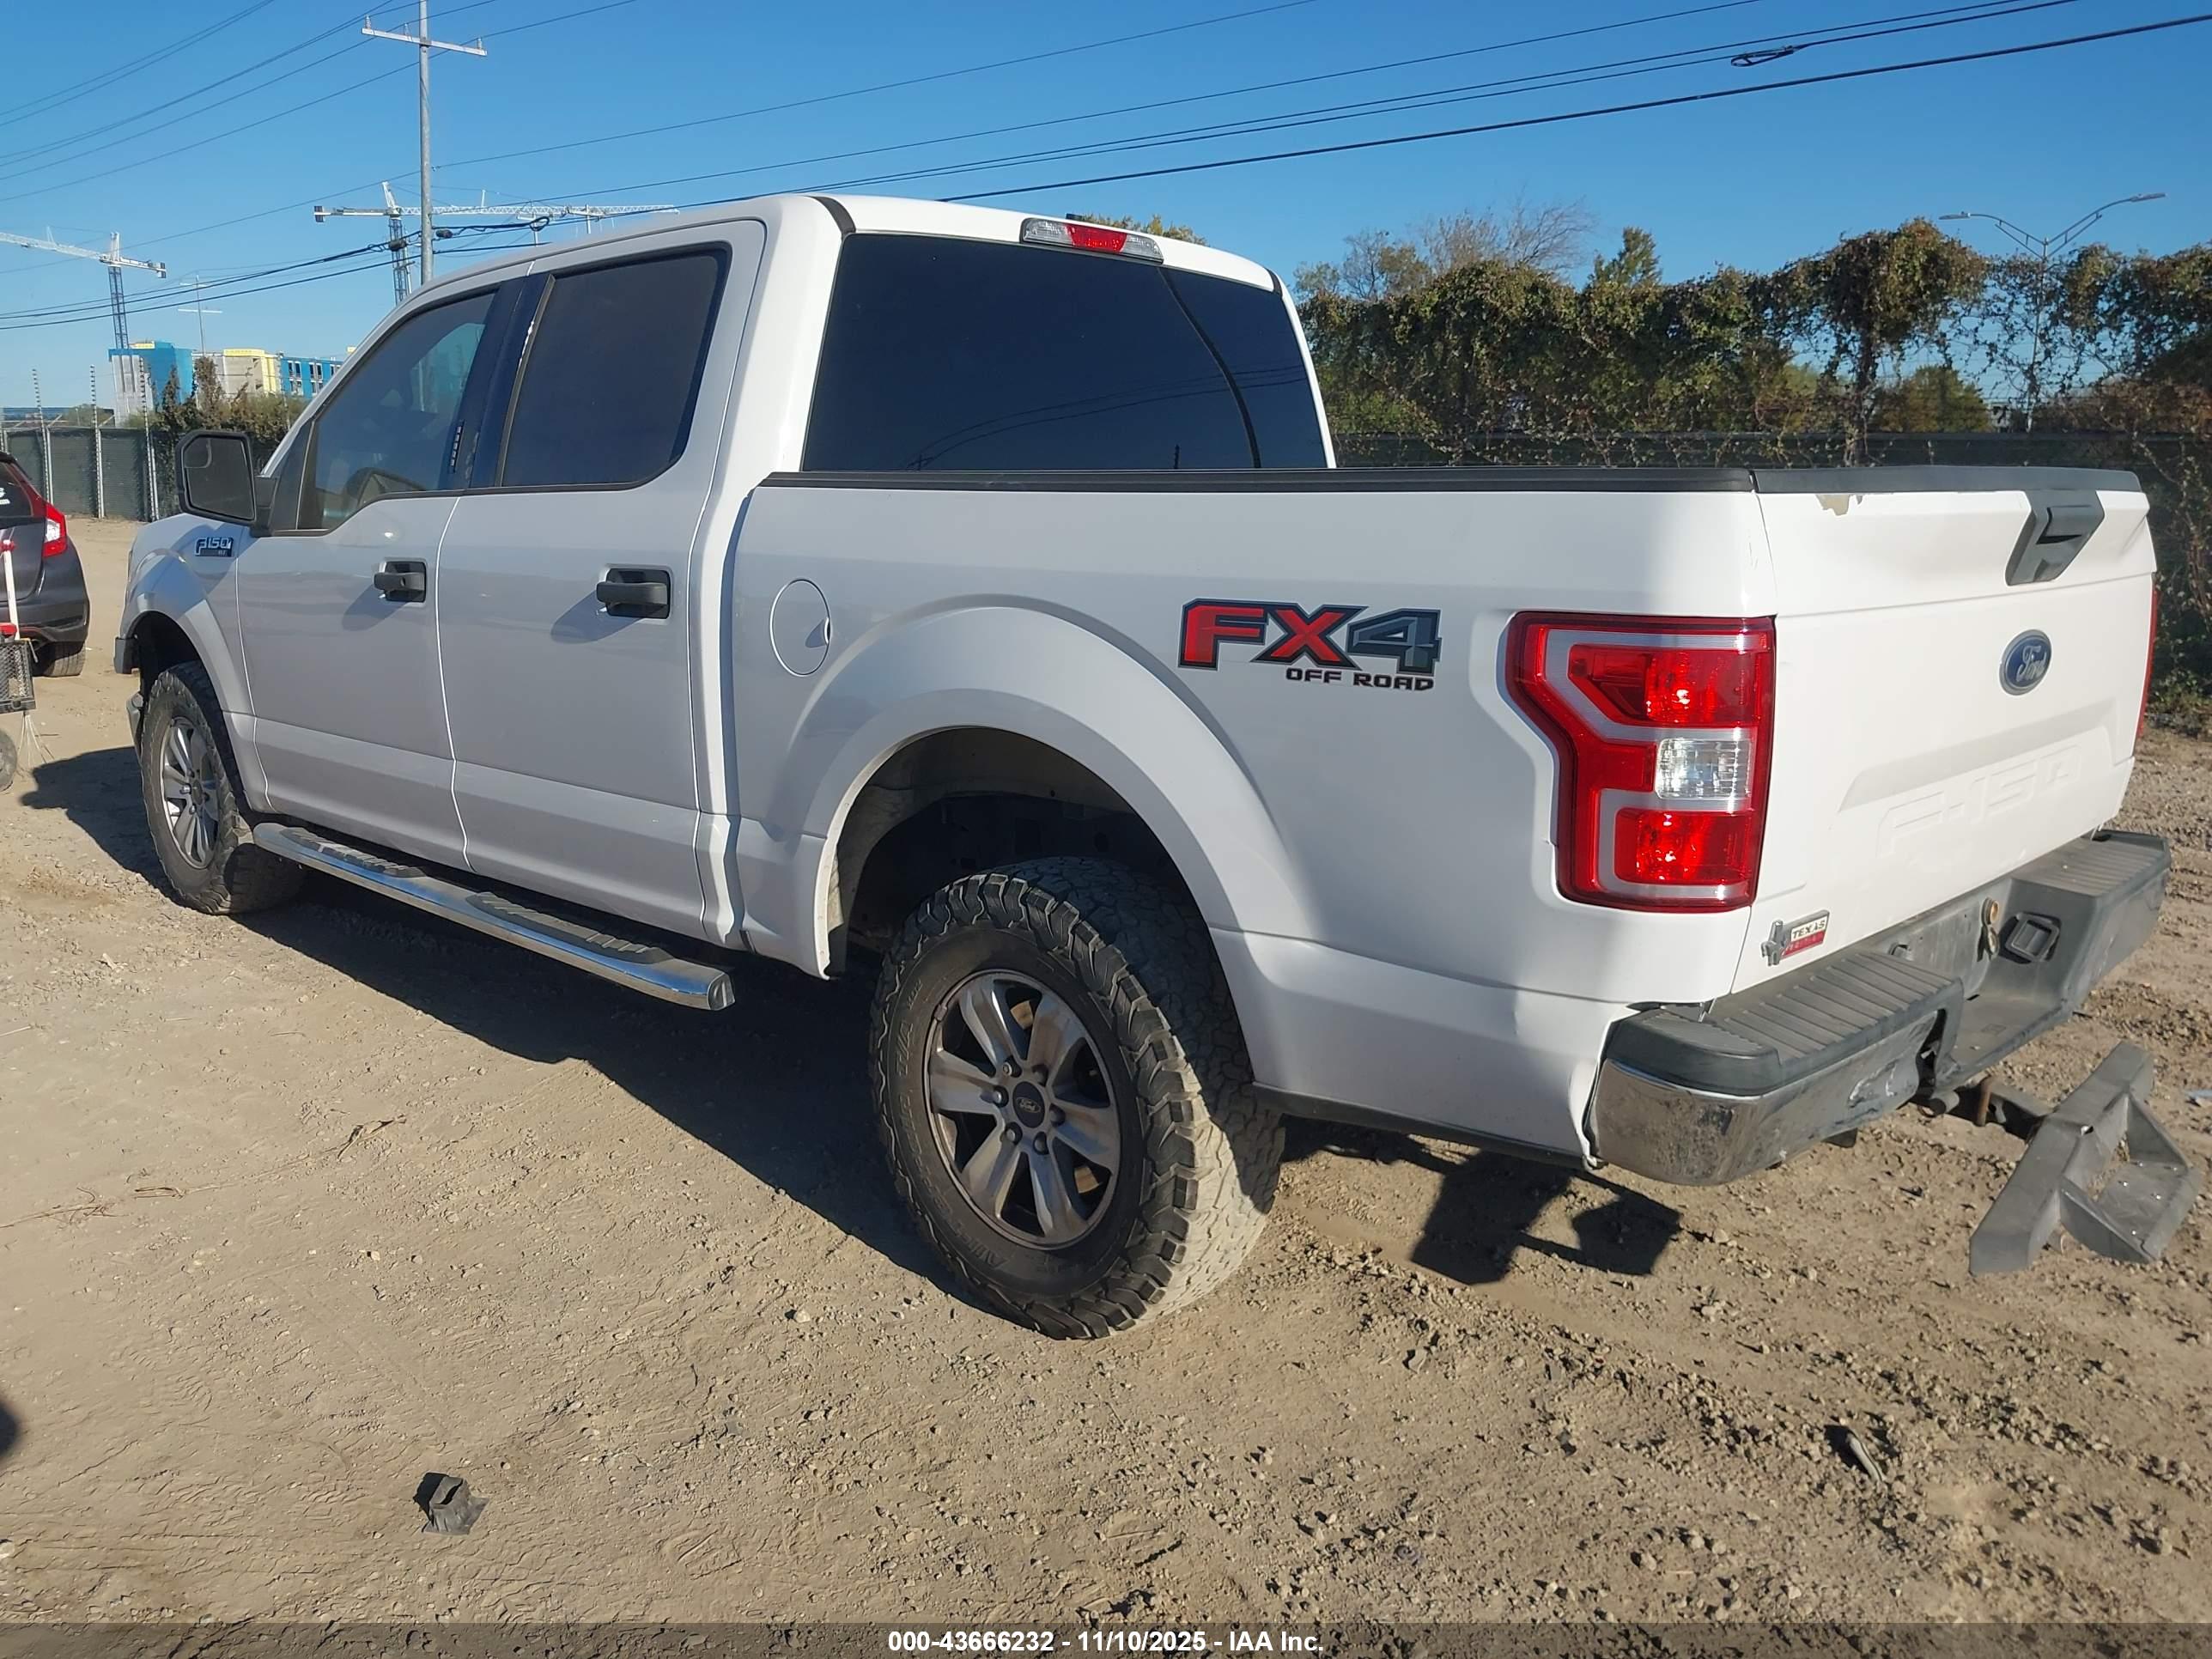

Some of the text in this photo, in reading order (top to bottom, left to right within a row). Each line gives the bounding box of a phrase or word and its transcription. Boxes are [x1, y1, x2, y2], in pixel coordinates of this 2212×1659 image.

[1178, 598, 1442, 676] FX4
[2015, 645, 2048, 682] Ford
[1285, 667, 1434, 691] OFF ROAD
[1792, 920, 1826, 939] TEXAS
